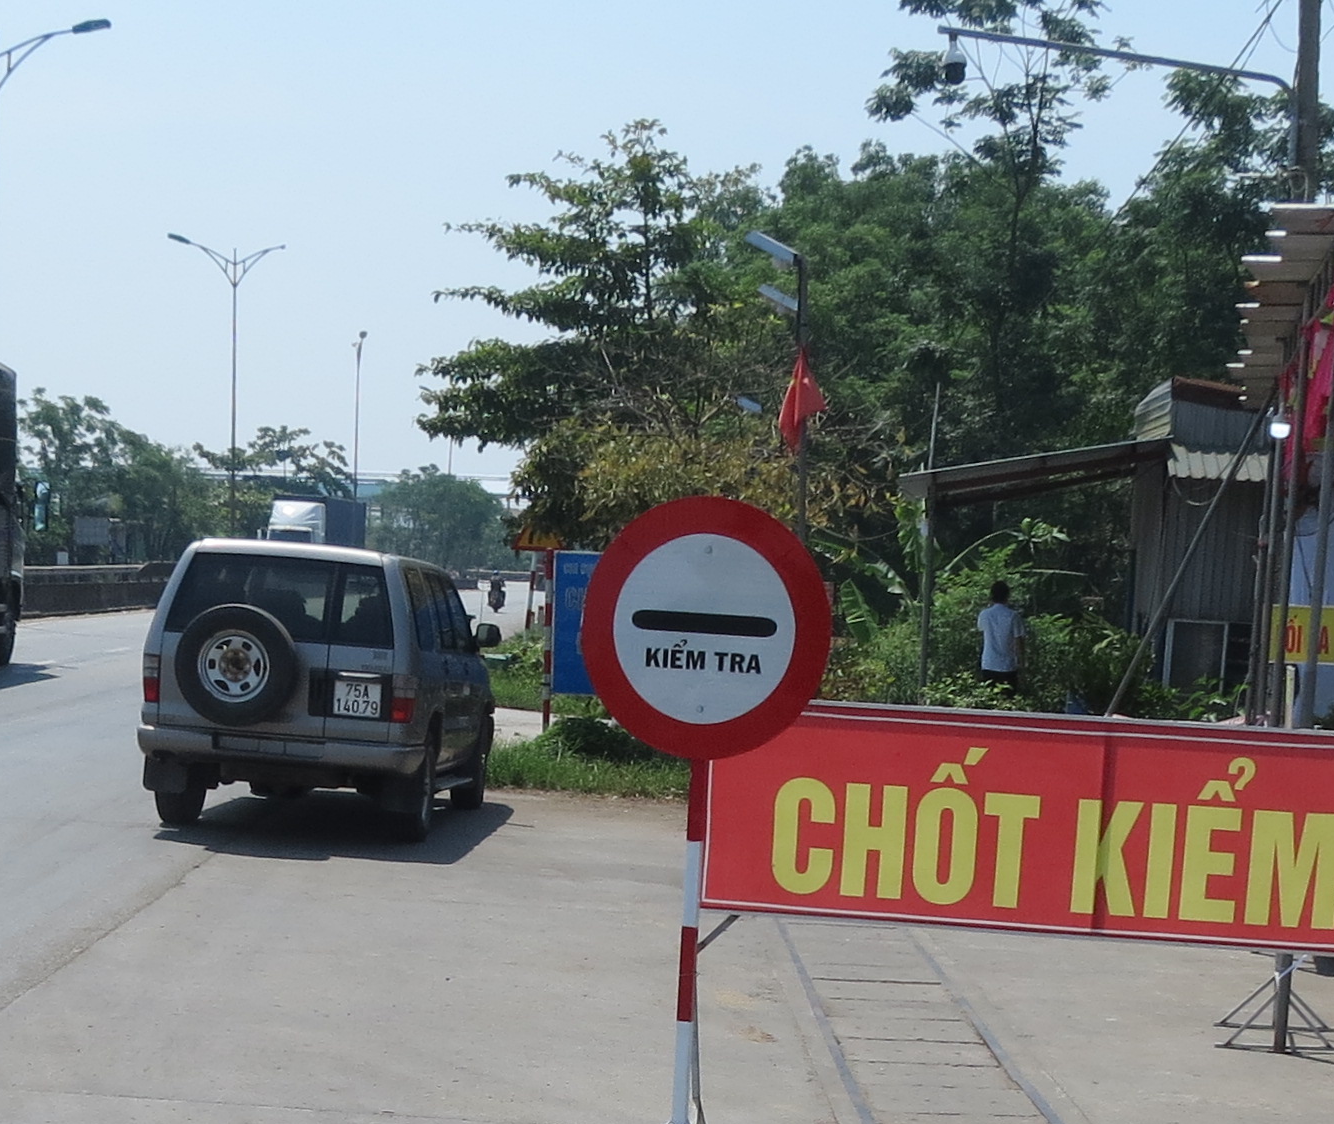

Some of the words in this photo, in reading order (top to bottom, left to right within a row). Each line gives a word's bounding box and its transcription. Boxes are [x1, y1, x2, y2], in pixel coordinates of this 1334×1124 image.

[645, 639, 706, 670] KIỂM
[714, 651, 761, 675] TRA
[346, 683, 370, 700] 75A
[771, 746, 1042, 910] CHỐT
